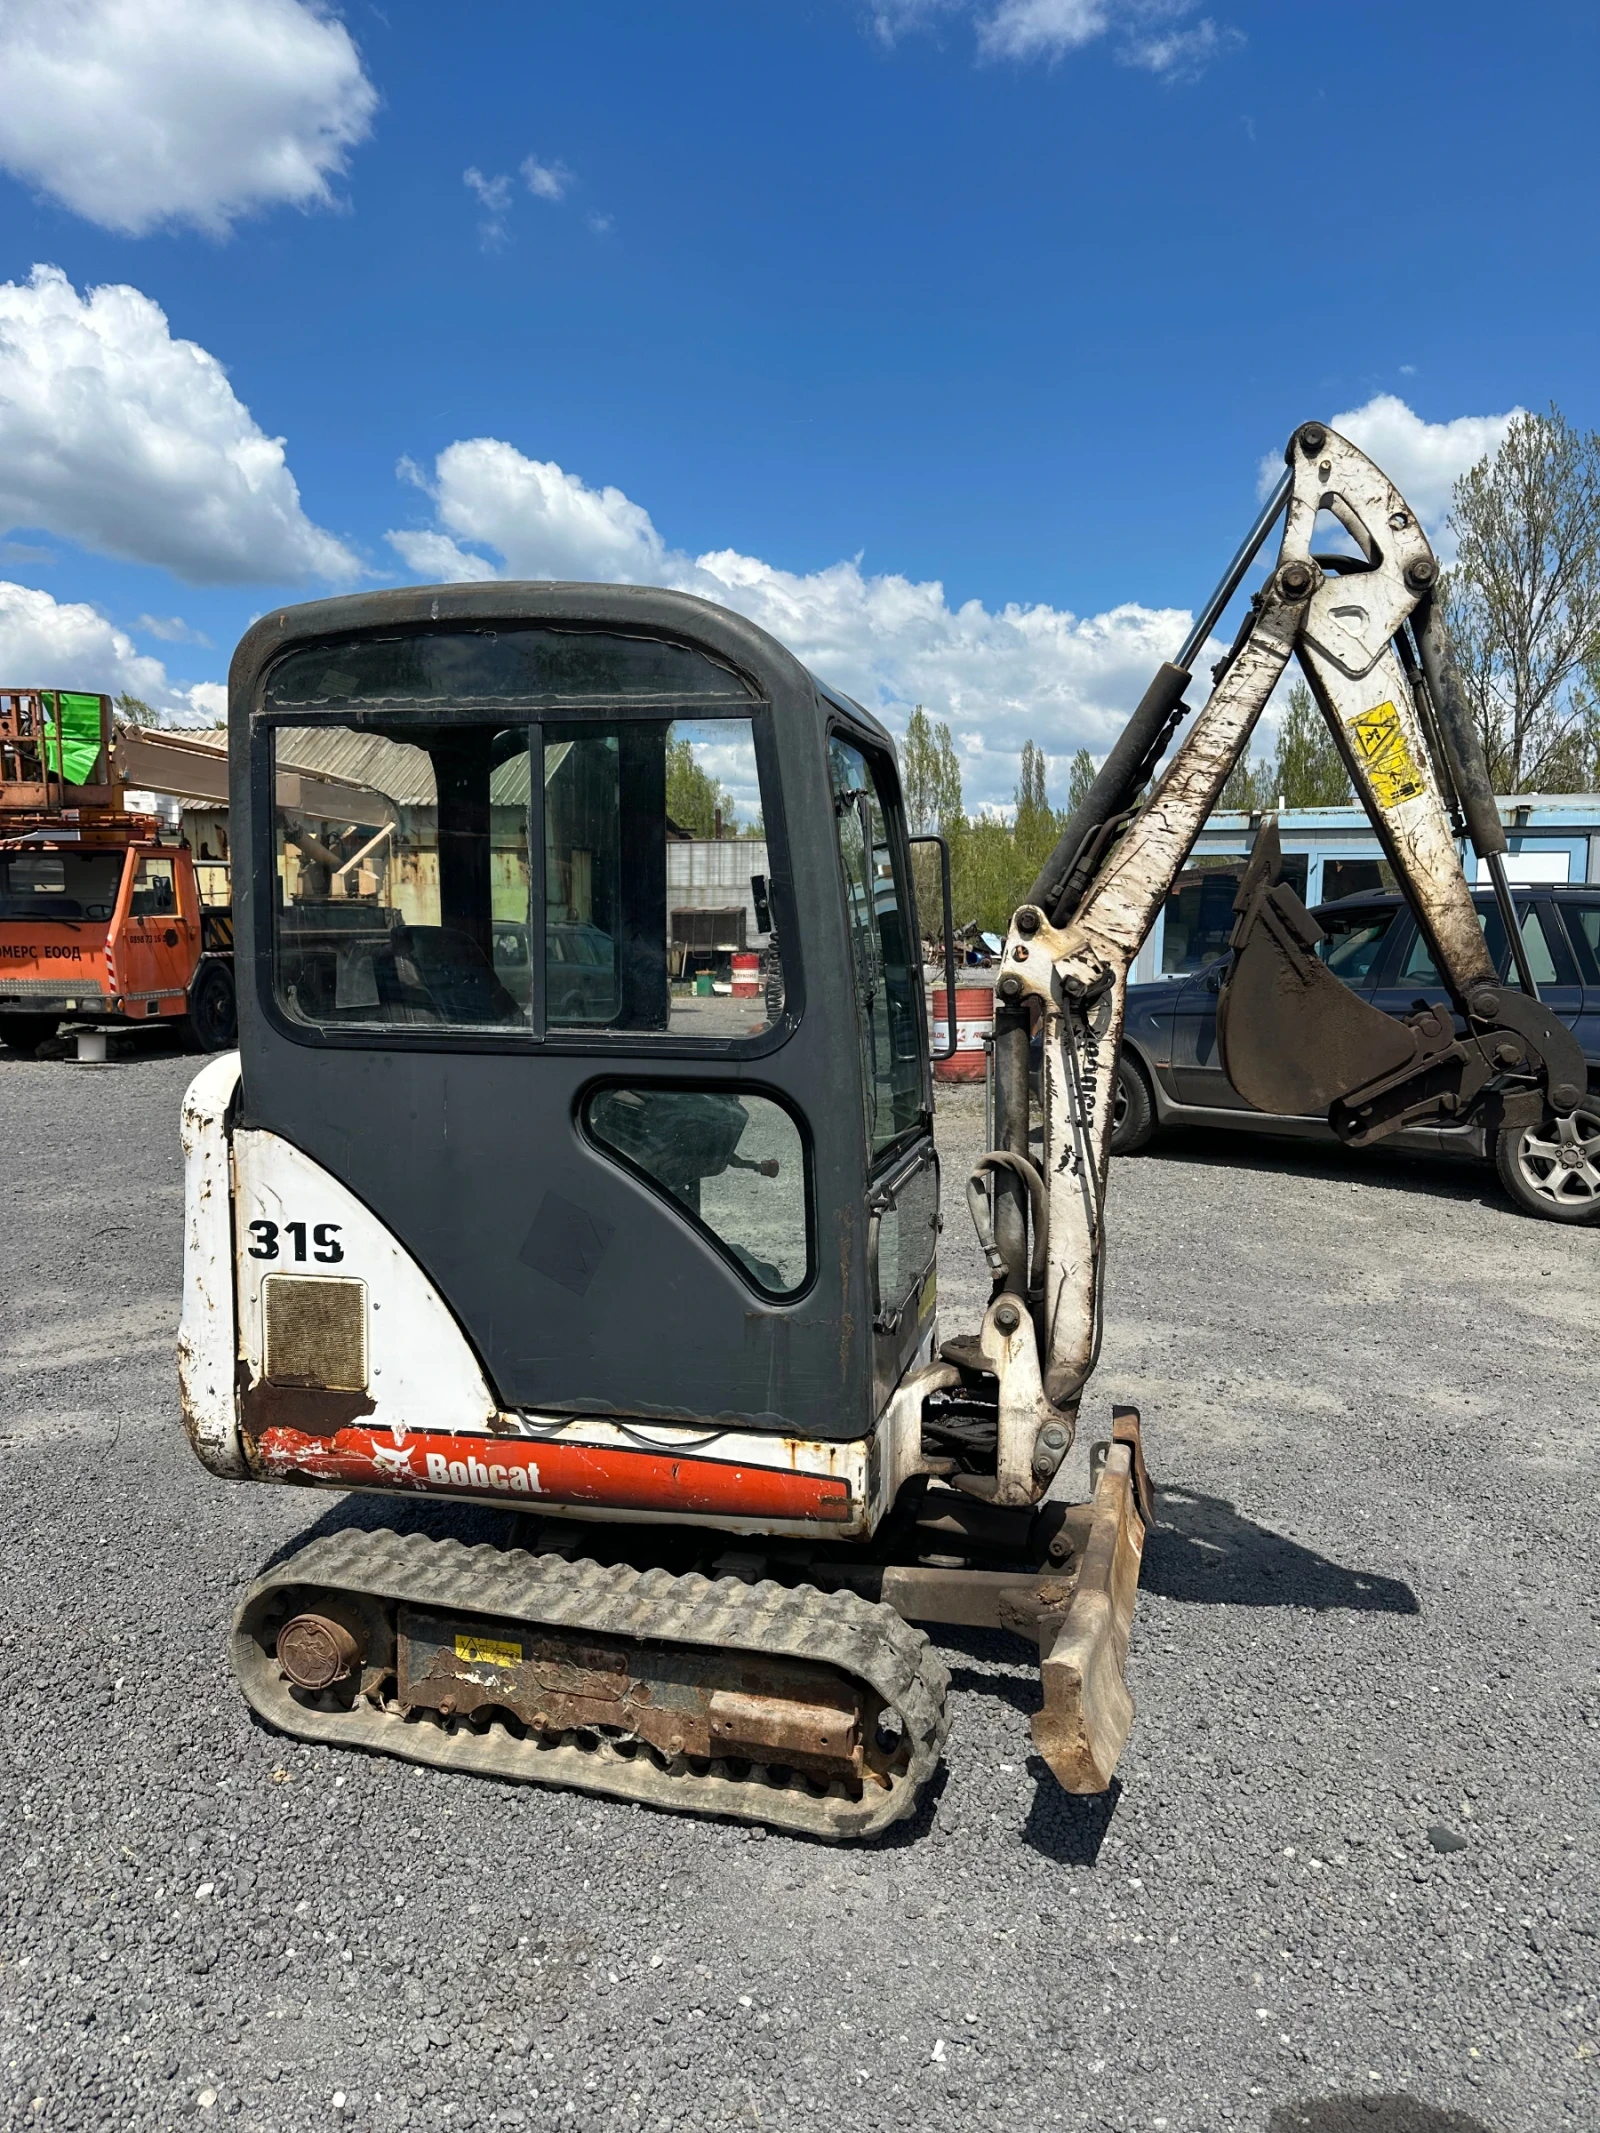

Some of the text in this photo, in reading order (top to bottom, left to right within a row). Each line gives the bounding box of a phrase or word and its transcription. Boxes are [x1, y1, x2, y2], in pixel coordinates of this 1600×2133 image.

[0, 945, 82, 962] МЕРС ЕООД
[425, 1452, 543, 1493] Bobcat
